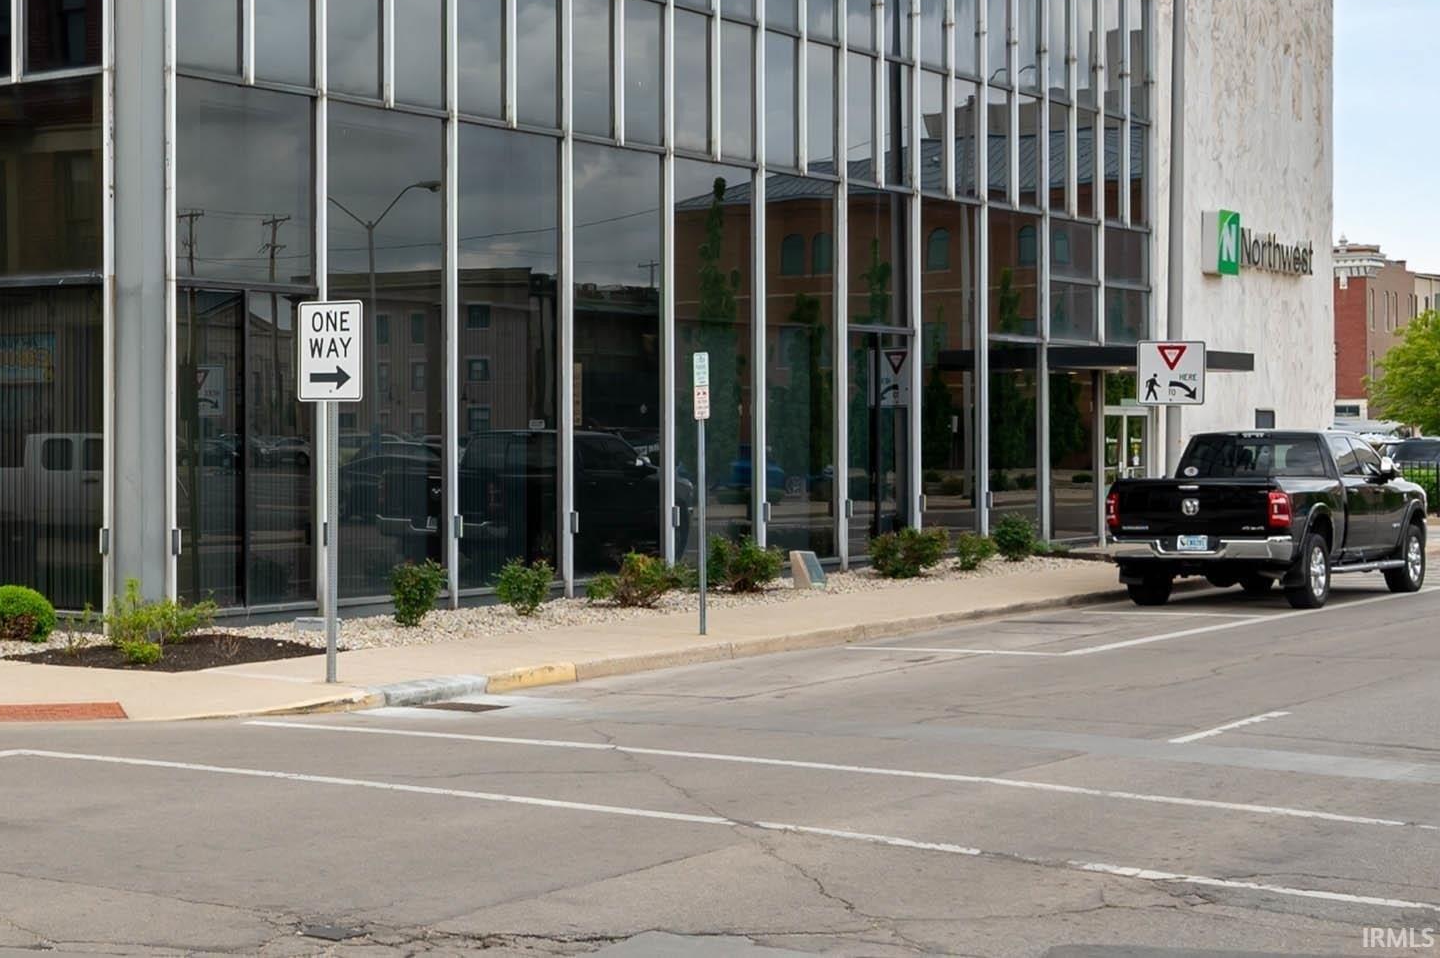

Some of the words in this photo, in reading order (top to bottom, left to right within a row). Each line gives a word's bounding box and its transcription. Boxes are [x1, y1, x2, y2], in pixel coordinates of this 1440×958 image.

[1240, 227, 1314, 276] Northwest
[312, 311, 350, 333] ONE
[309, 337, 352, 358] WAY
[1179, 373, 1198, 381] HERE
[1168, 388, 1176, 396] TO
